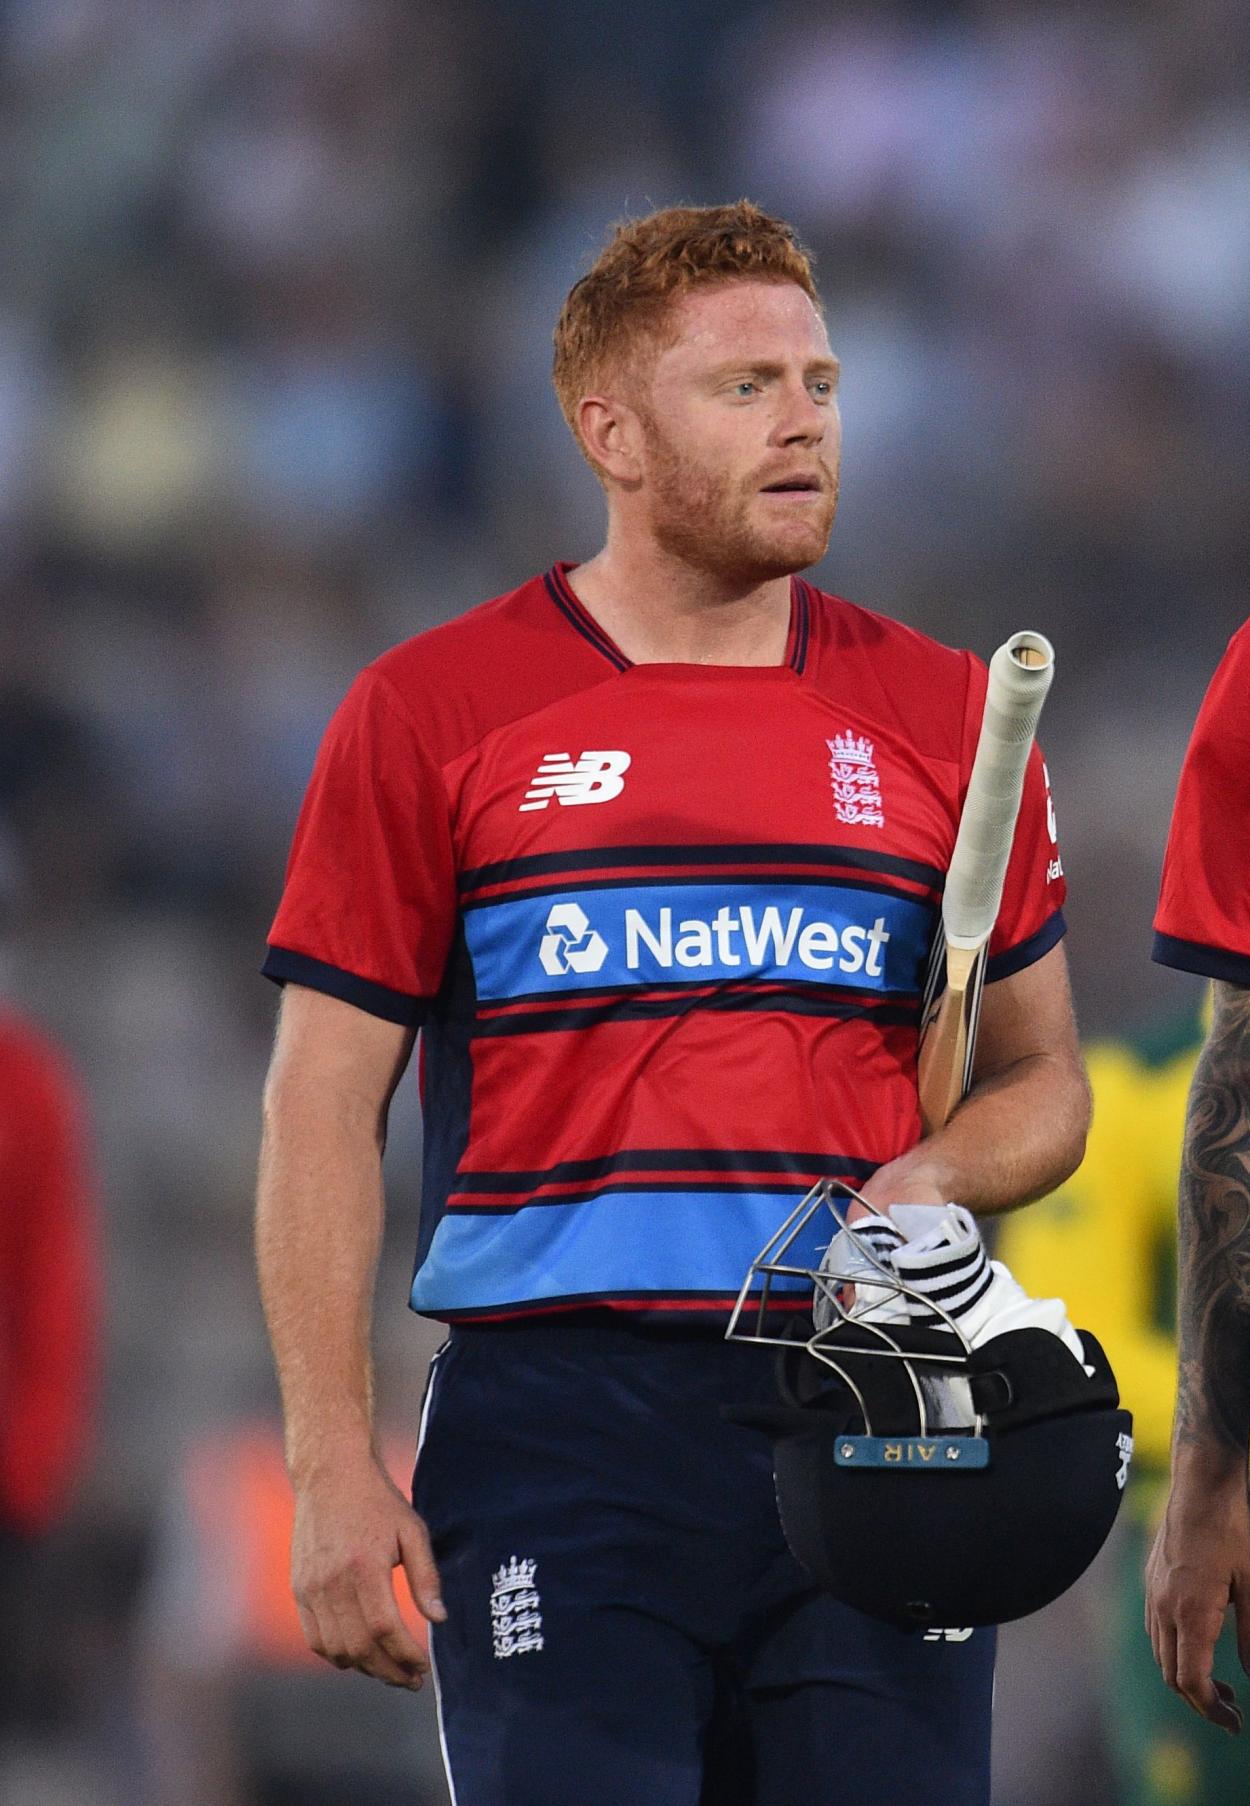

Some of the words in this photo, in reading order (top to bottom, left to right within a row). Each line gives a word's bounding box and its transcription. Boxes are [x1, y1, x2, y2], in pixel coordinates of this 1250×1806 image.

[518, 750, 632, 812] NB
[625, 906, 890, 977] NatWest
[884, 1444, 937, 1462] AIR
